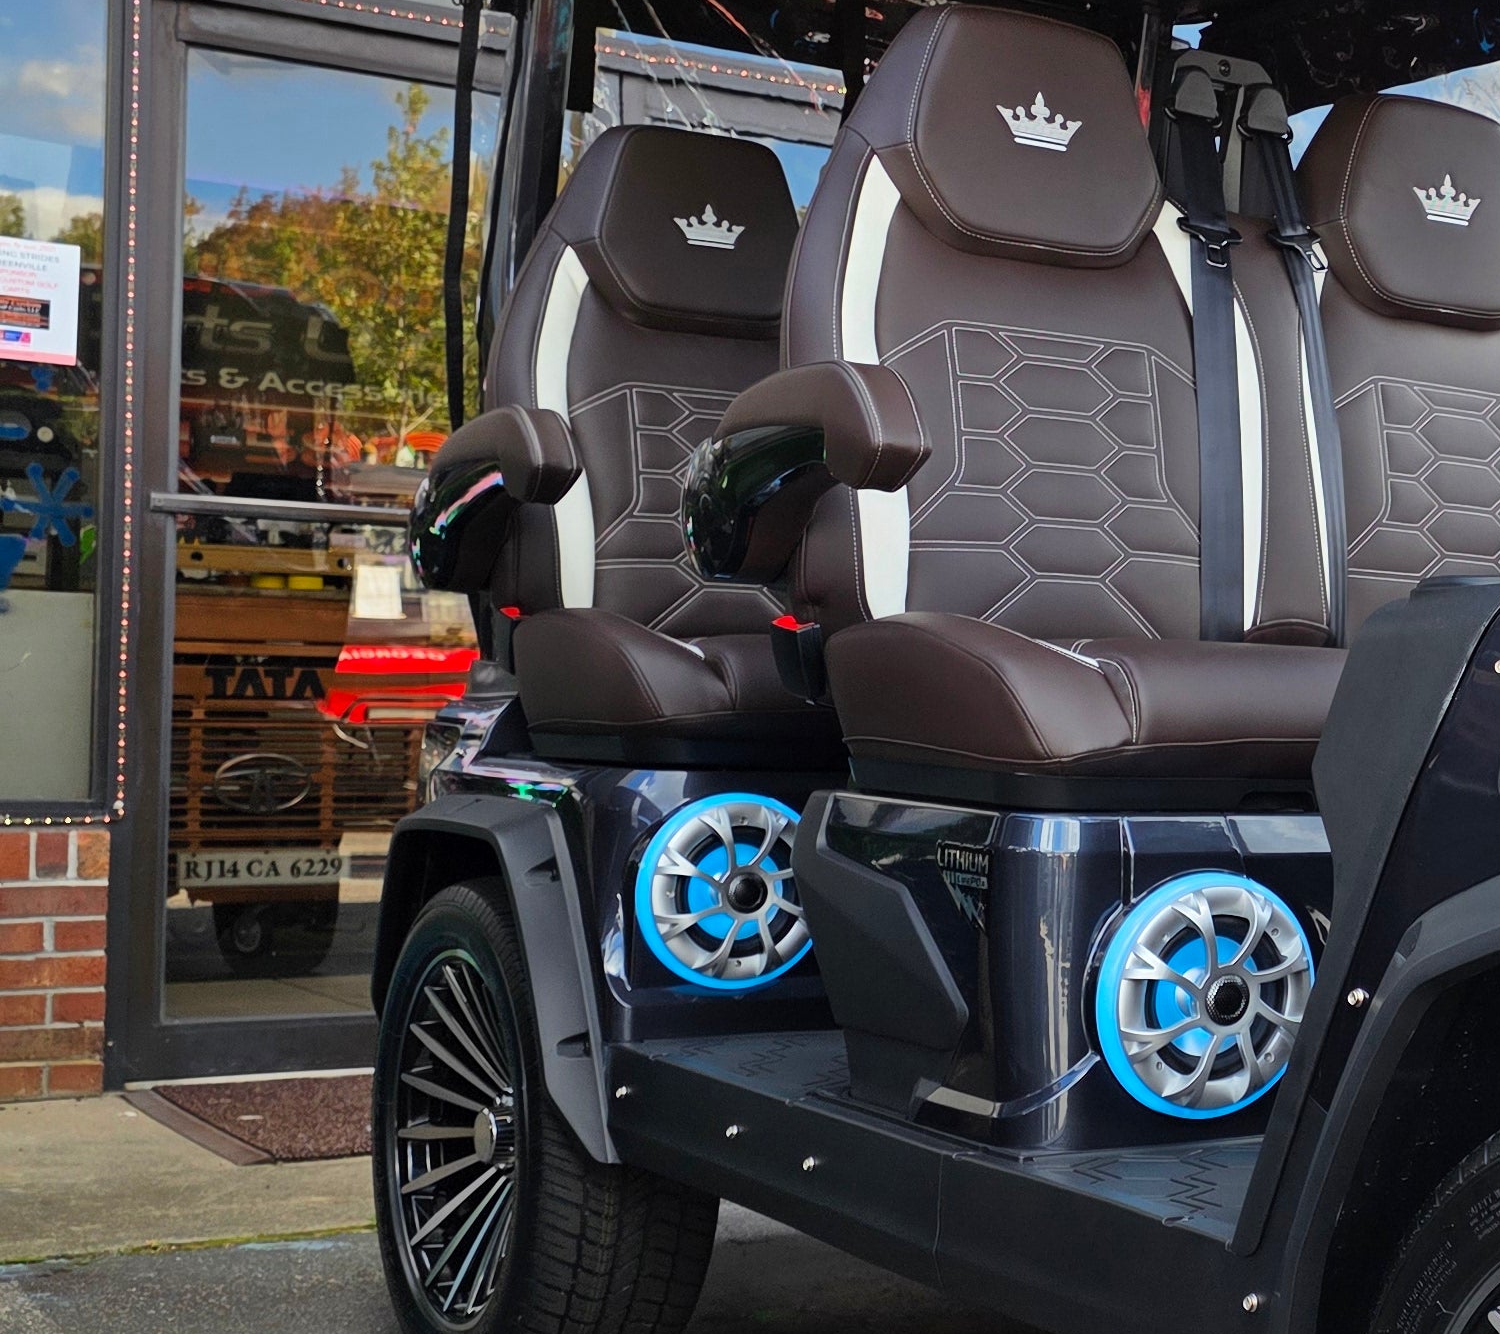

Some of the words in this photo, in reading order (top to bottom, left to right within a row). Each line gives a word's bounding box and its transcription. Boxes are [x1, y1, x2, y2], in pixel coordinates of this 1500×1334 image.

[219, 367, 249, 389] &
[205, 667, 326, 700] TATA
[246, 859, 281, 878] CA
[290, 858, 343, 878] 6229
[937, 847, 990, 875] LITHIUM
